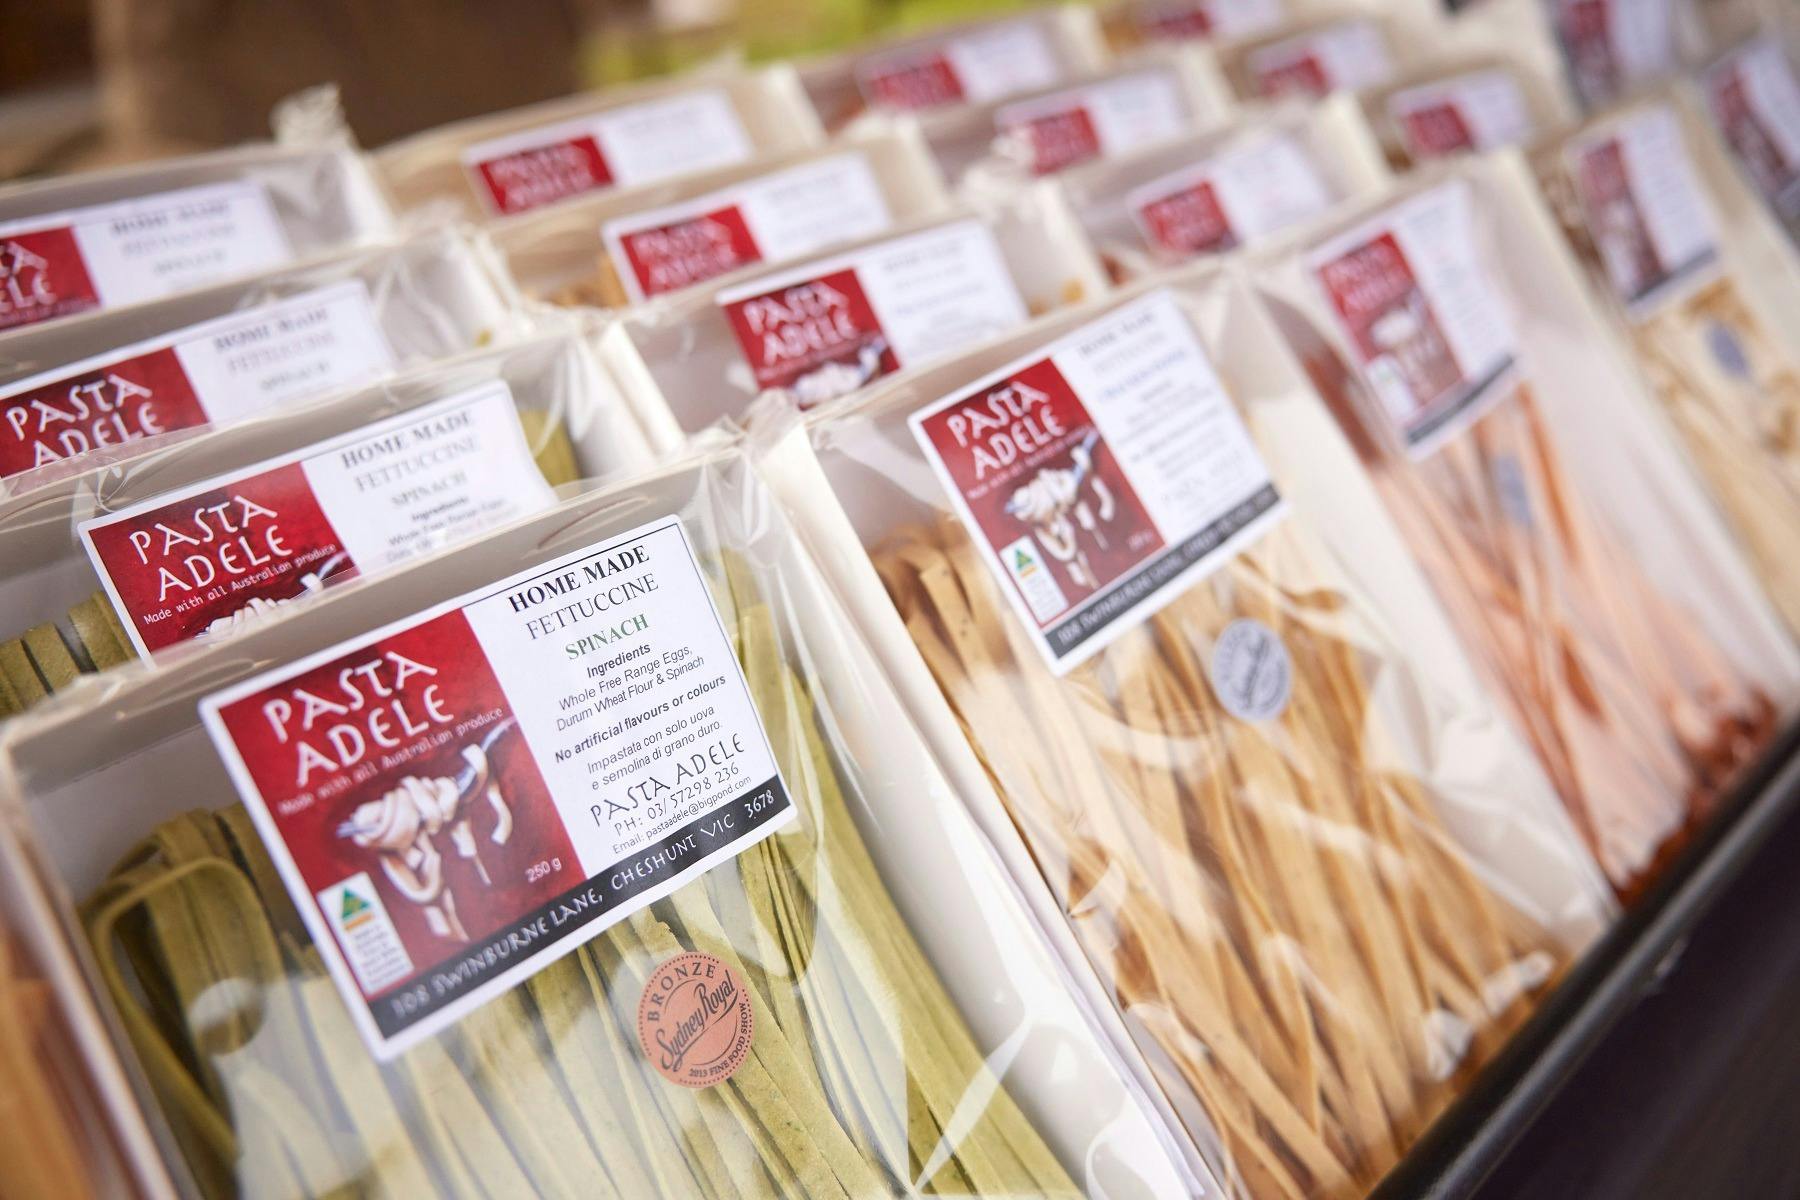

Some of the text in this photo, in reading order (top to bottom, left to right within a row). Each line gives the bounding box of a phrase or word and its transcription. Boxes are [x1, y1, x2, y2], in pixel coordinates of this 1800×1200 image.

[763, 306, 858, 366] ADELE
[6, 373, 153, 441] PASTA
[33, 401, 165, 468] ADELE
[341, 411, 472, 469] HOME MADE
[947, 381, 1050, 448] PASTA
[354, 437, 476, 492] FETTUCCINE
[971, 404, 1066, 480] ADELE
[129, 495, 278, 565] PASTA
[158, 525, 293, 602] ADELE
[143, 544, 337, 625] Made with all Australian produce
[508, 545, 650, 613] HOME MADE
[525, 573, 659, 640] FETTUCCINE
[564, 613, 650, 660] SPINACH
[586, 643, 651, 678] Ingredients
[262, 651, 439, 743] PASTA
[556, 655, 705, 731] Durum Wheat Flour & Spinach
[558, 645, 693, 711] Whole Free Range Eggs,
[296, 684, 455, 788] ADELE
[382, 730, 454, 770] Australian
[456, 707, 504, 738] produce
[555, 675, 727, 763] No artificial flavours or colours
[587, 705, 715, 774] Impastata con solo uova
[592, 780, 600, 790] e
[602, 755, 651, 787] semolina
[652, 747, 662, 761] di
[665, 733, 696, 757] grano
[675, 733, 745, 785] ADELE
[589, 776, 671, 827] PASTA
[612, 776, 752, 855] Email: pastaadele@bigpond.com
[614, 815, 644, 837] PH:
[714, 762, 739, 784] 236
[431, 917, 549, 996] SWINBURNE
[550, 888, 604, 928] LANE,
[611, 834, 697, 890] CHESHUNT
[700, 813, 735, 837] VIC
[744, 789, 775, 819] 3678
[525, 857, 562, 884] 250 g
[647, 962, 716, 1022] BRONZE
[656, 969, 735, 1072] Sydney Royal
[688, 1002, 748, 1078] 2013 FINE FOOD SHOW
